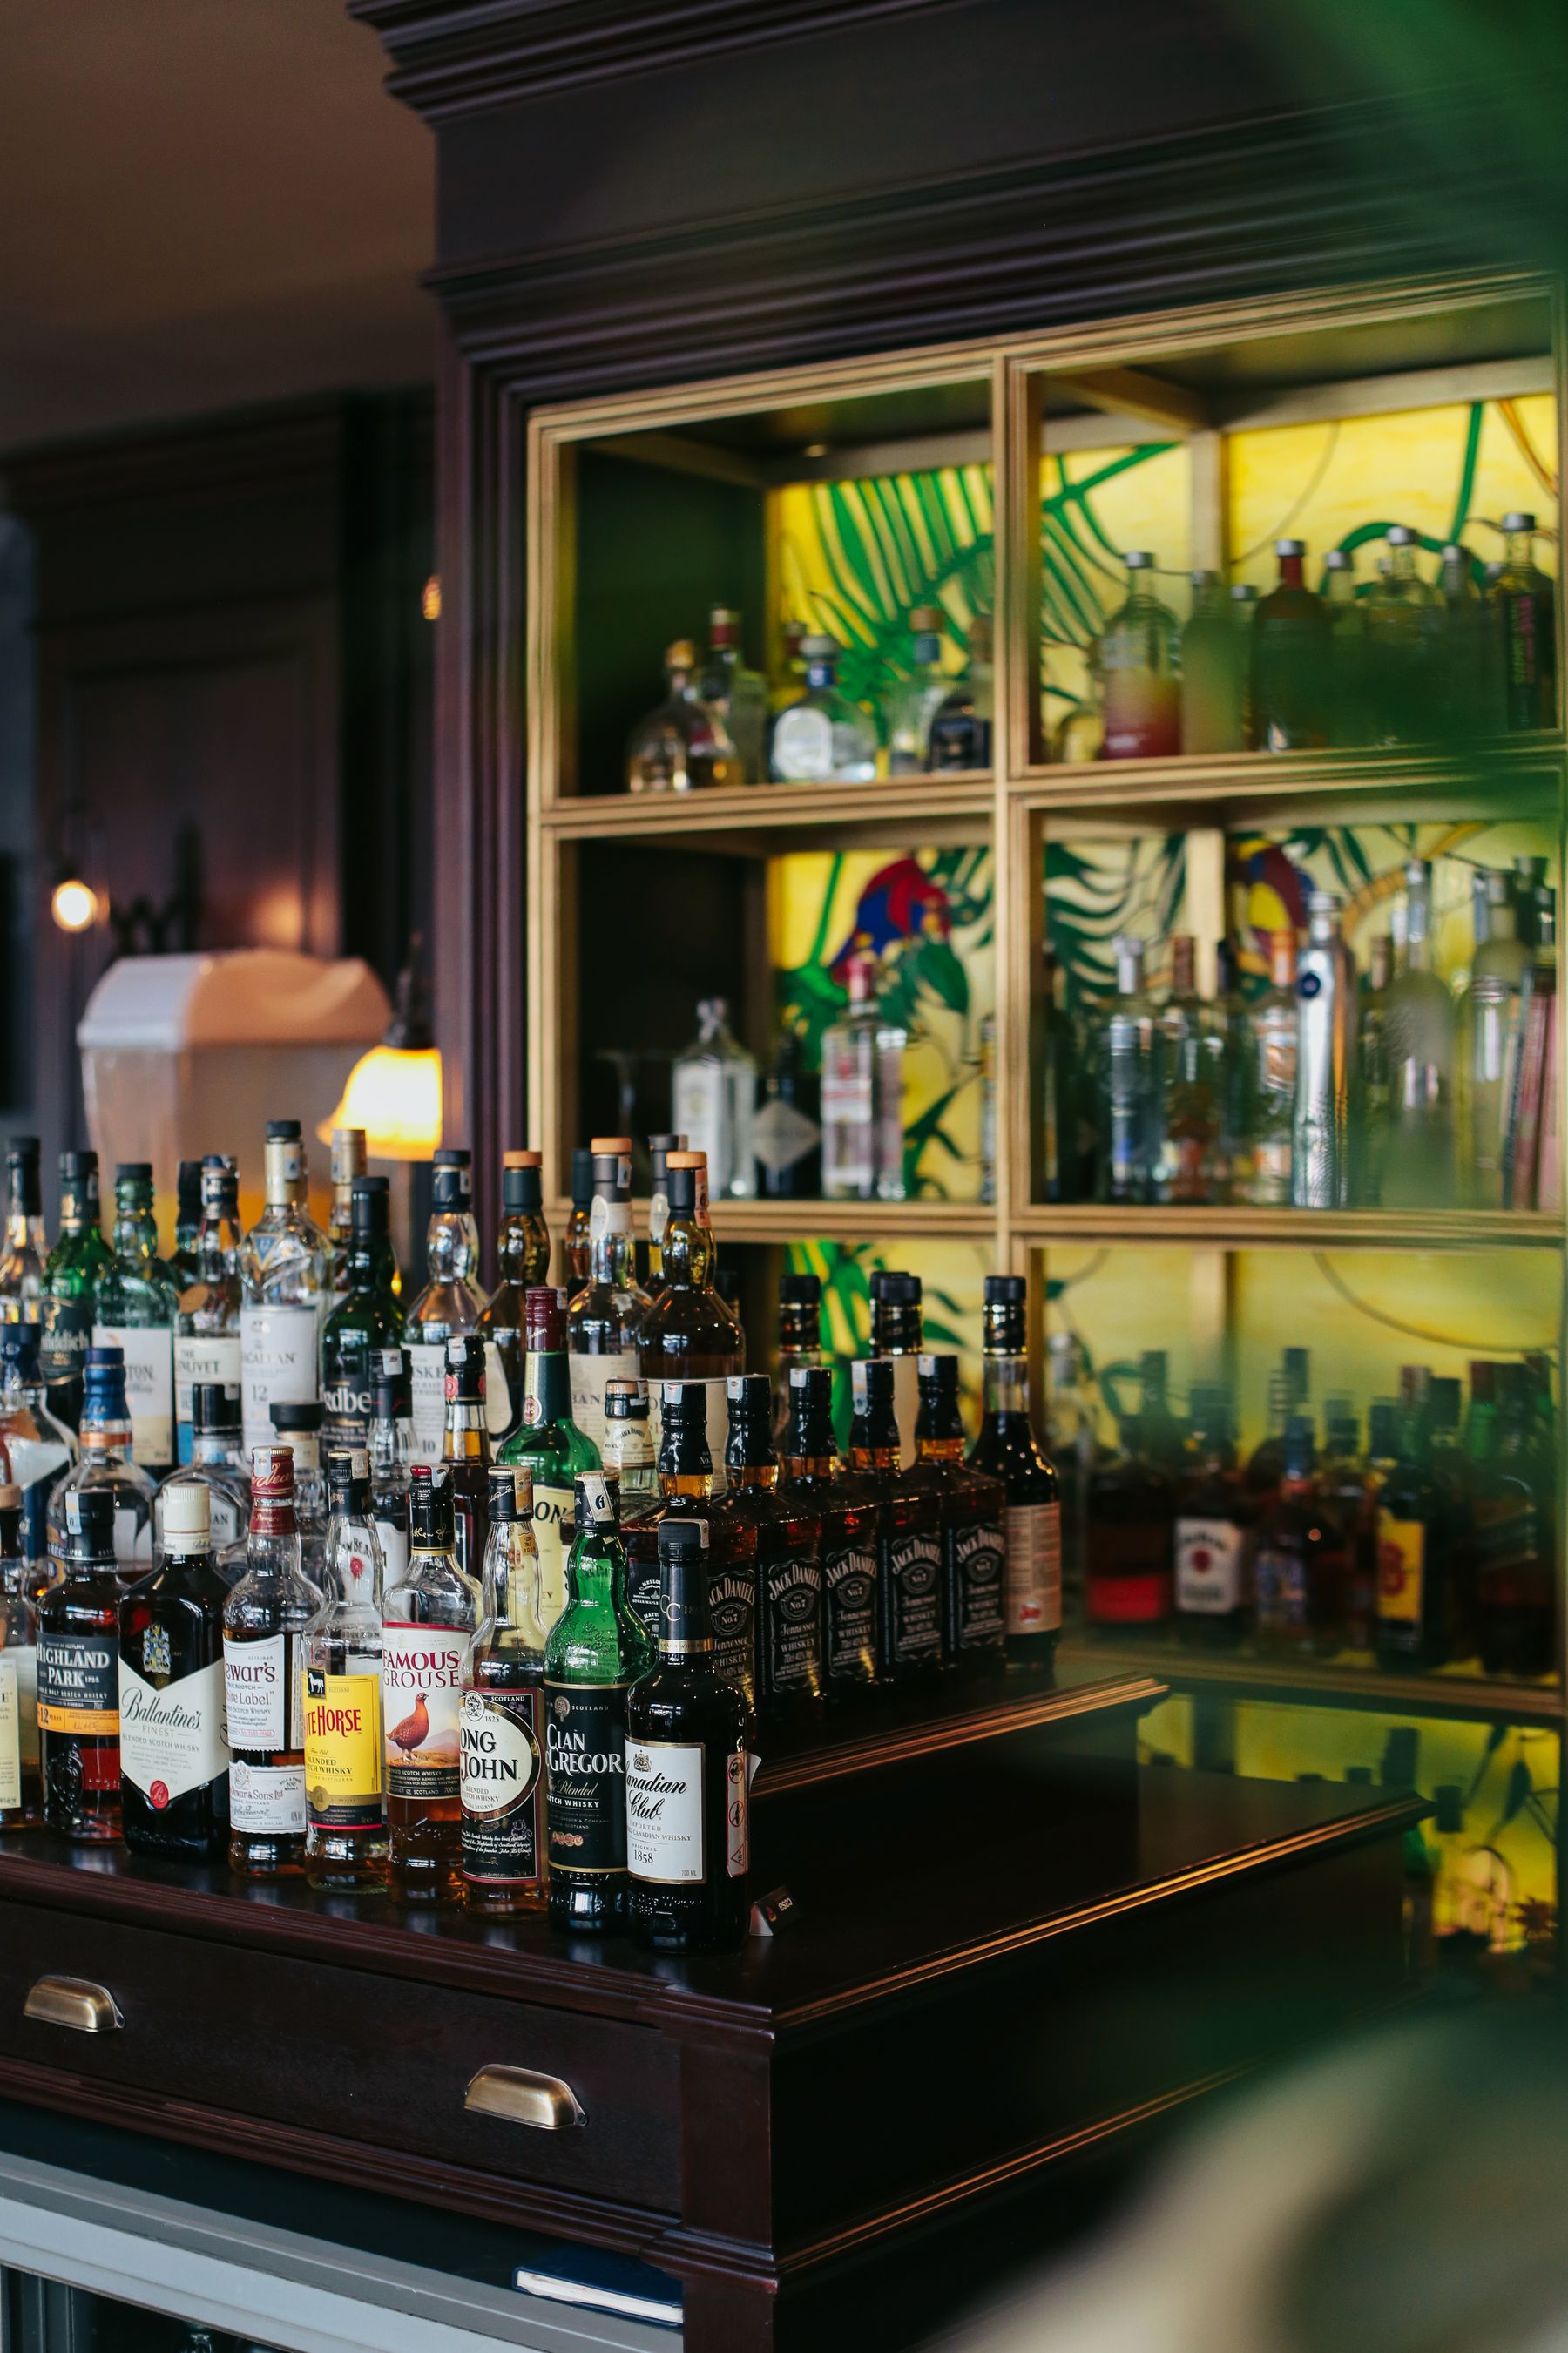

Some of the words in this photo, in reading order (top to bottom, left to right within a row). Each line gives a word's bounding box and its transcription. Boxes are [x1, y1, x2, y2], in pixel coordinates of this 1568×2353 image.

[253, 1385, 267, 1401] 12
[422, 1439, 435, 1453] 10
[826, 1559, 850, 1588] JACK
[767, 1571, 793, 1601] JACK
[789, 1599, 806, 1611] No.7
[721, 1613, 739, 1626] No.7
[780, 1622, 817, 1638] Tennessee
[781, 1638, 816, 1653] WHISKEY
[37, 1641, 110, 1670] HIGHLAND
[382, 1649, 459, 1670] FAMOUS
[48, 1667, 85, 1688] PARK
[383, 1667, 458, 1688] GROUSE
[84, 1691, 107, 1700] WHISKY
[39, 1707, 49, 1724] 12
[121, 1687, 202, 1730] Ballantine's
[317, 1705, 362, 1738] HORSE
[142, 1725, 174, 1737] FINEST
[546, 1723, 586, 1752] CLAN
[122, 1732, 147, 1744] BLENDED
[149, 1737, 173, 1748] SCOTCH
[174, 1743, 200, 1753] WHISKY
[460, 1727, 496, 1753] ONG
[307, 1755, 336, 1766] BLENDED
[460, 1751, 519, 1782] JOHN
[318, 1766, 352, 1775] WHISKY
[253, 1789, 274, 1801] Sons
[466, 1785, 489, 1795] BLENDED
[476, 1793, 500, 1802] WHISKY
[564, 1799, 599, 1808] WHISKY
[628, 1789, 666, 1821] Club
[633, 1829, 660, 1840] CANADIAN
[632, 1843, 657, 1852] ORIGINAL
[634, 1849, 653, 1864] 1858
